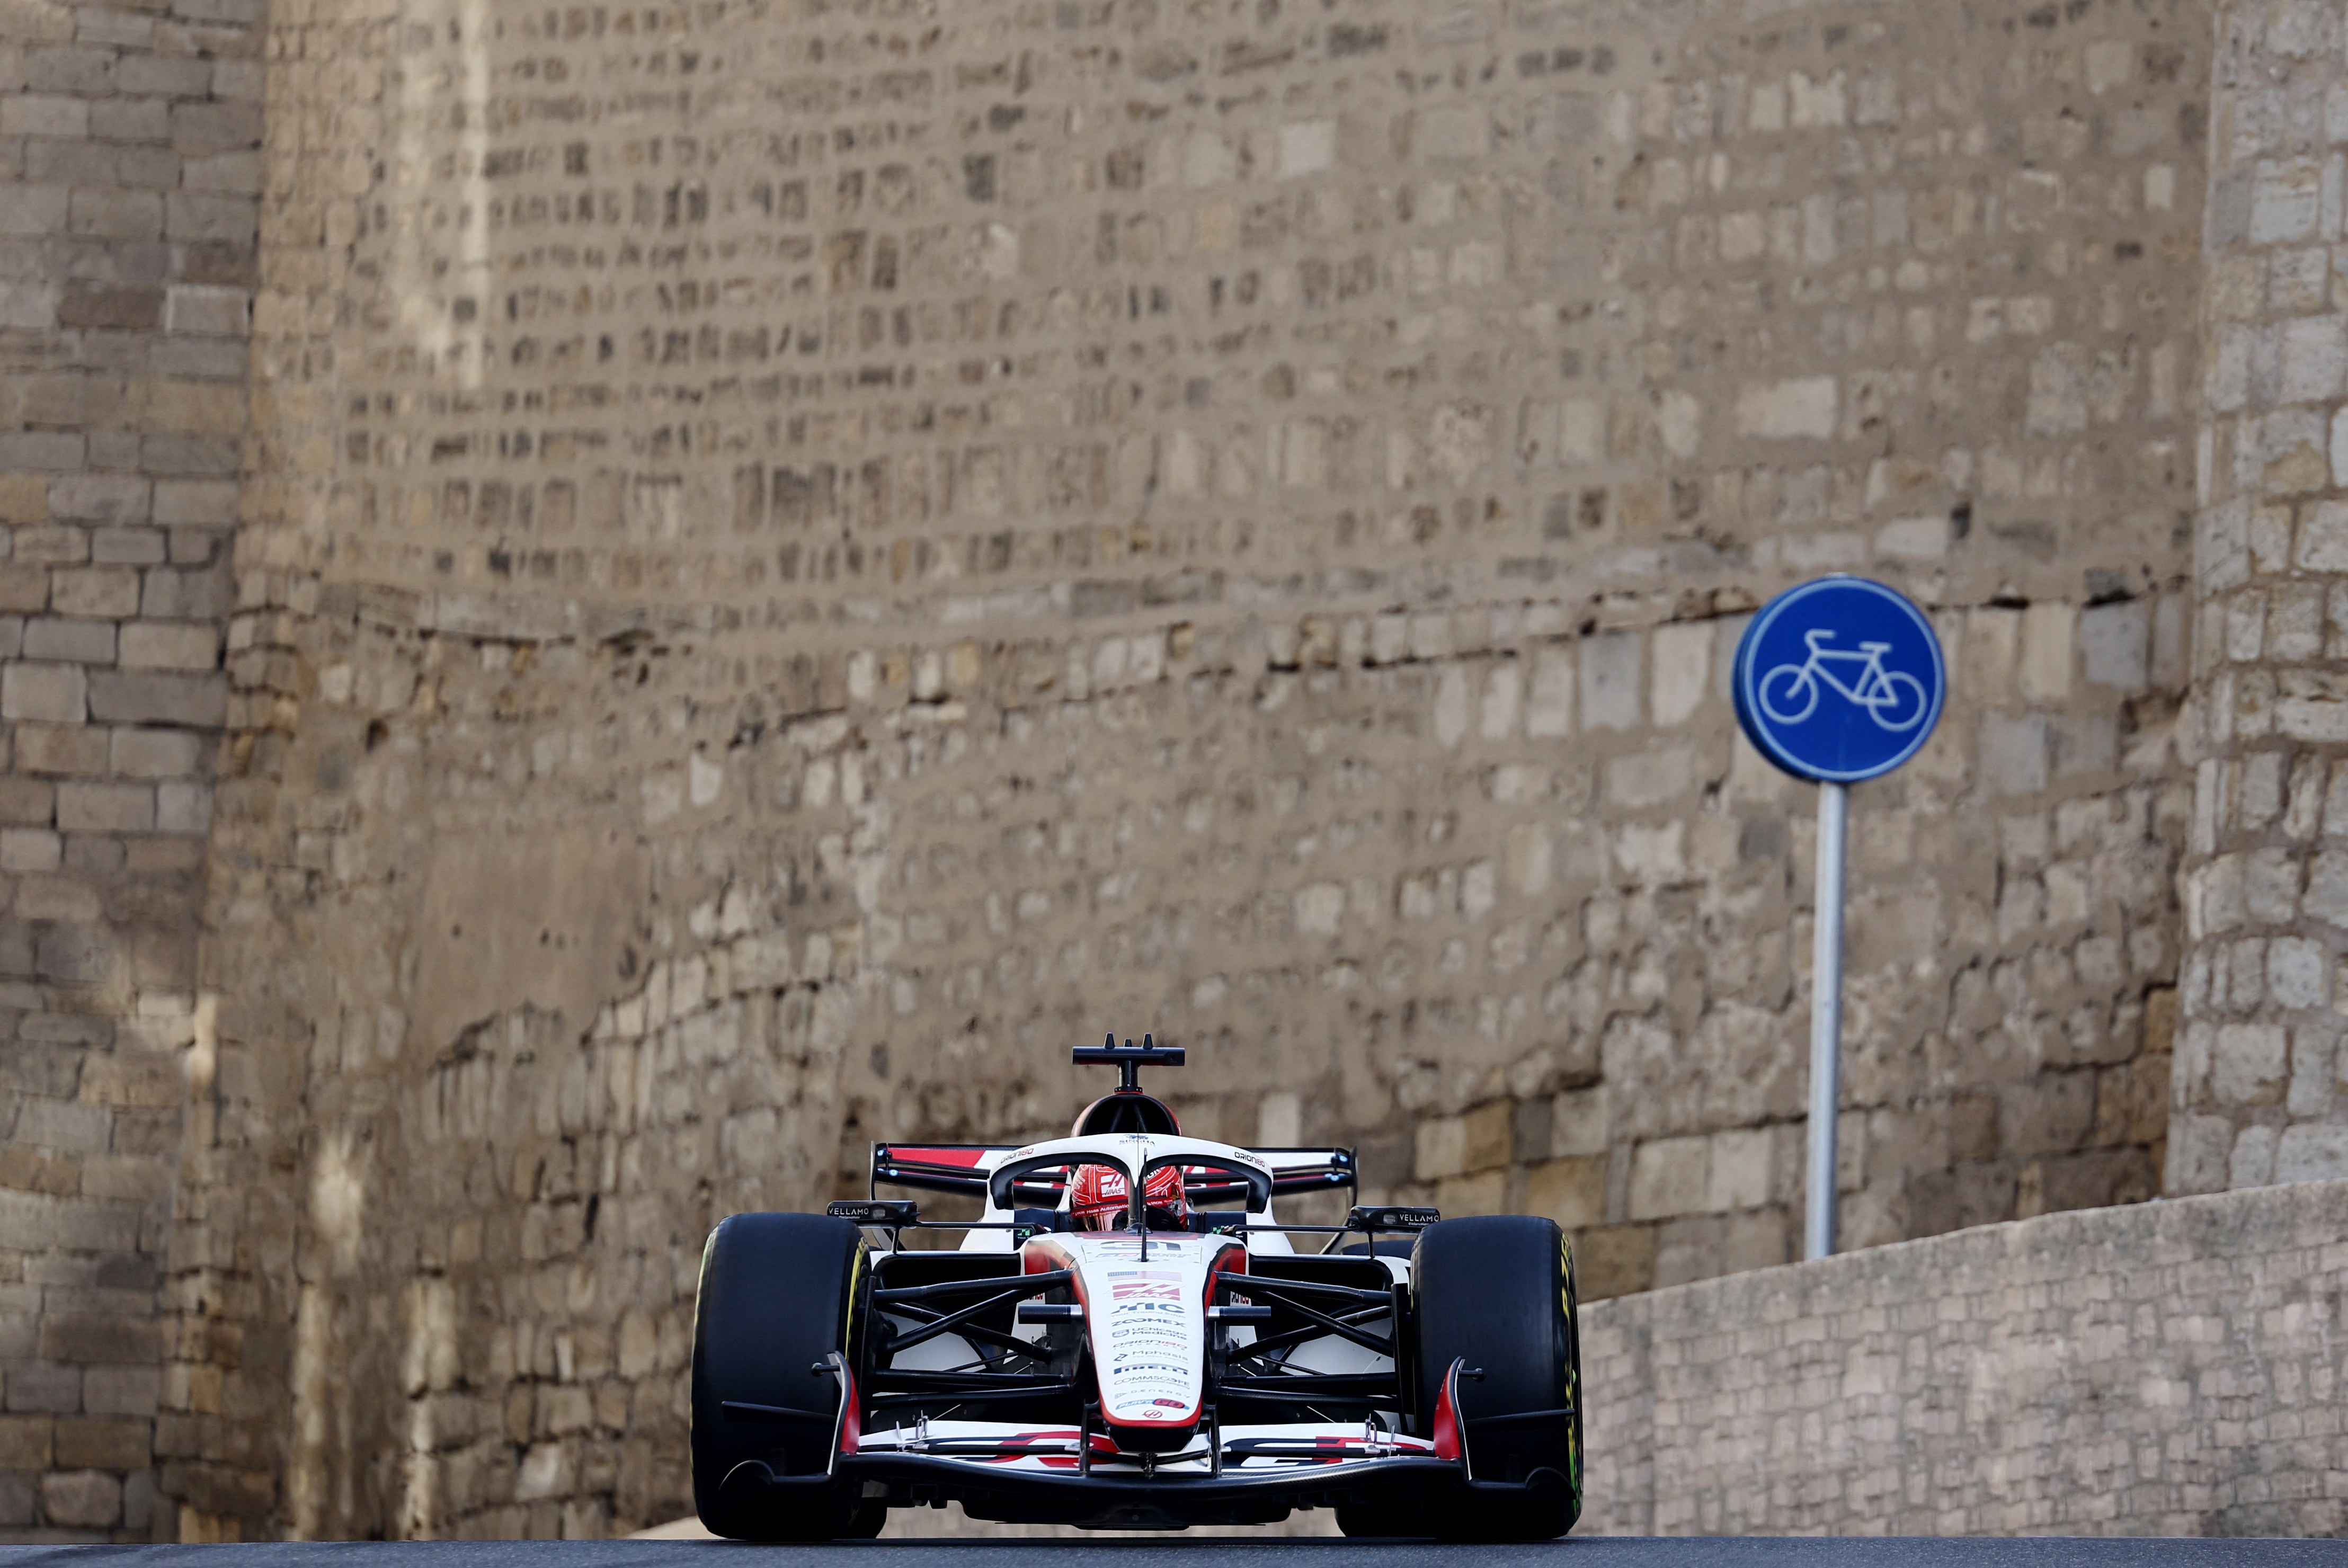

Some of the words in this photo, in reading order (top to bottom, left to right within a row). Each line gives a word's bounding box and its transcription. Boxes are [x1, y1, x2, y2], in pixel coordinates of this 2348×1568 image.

[1400, 1214, 1439, 1222] VELLAMO
[1111, 1318, 1186, 1328] ZOOMEX
[1132, 1327, 1187, 1337] UChicago
[1132, 1331, 1187, 1340] Medicine
[1132, 1350, 1188, 1361] Mphasis
[1114, 1363, 1189, 1375] PIRELLI
[1114, 1376, 1190, 1387] COMMSCOPE
